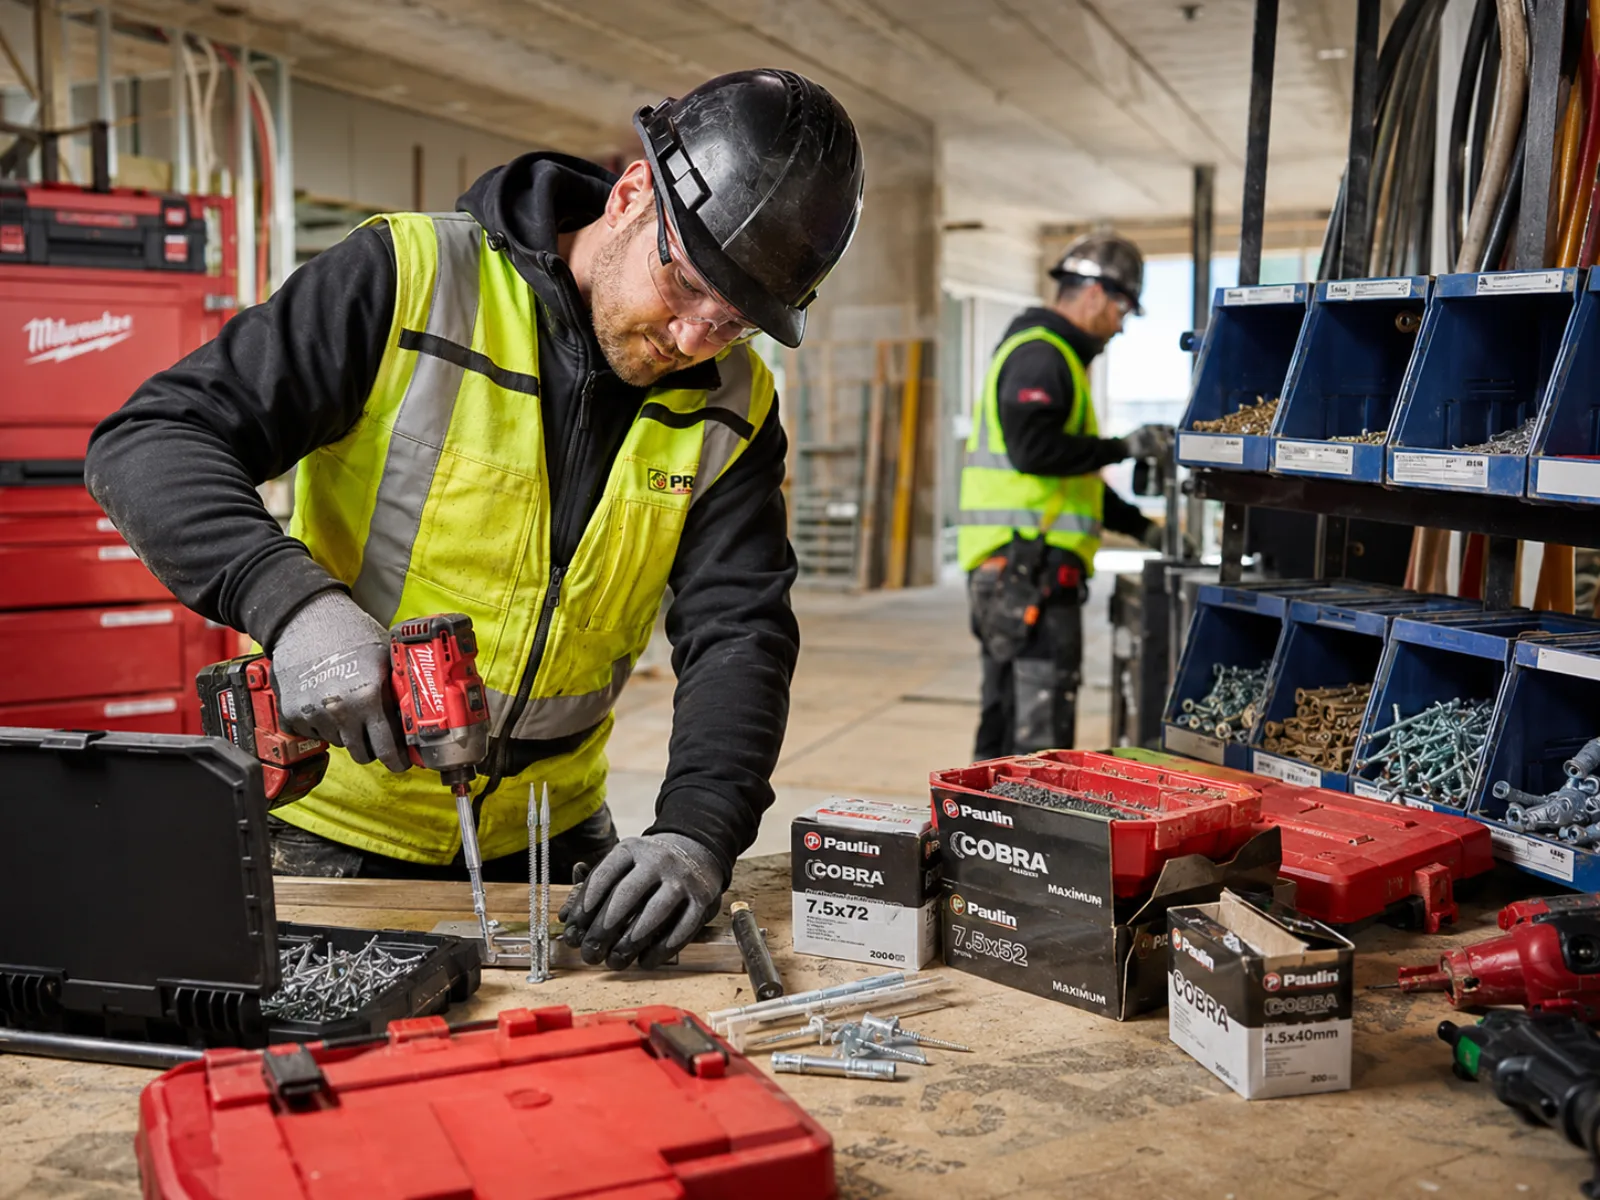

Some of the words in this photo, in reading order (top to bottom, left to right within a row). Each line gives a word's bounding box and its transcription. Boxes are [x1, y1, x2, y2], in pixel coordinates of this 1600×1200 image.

[960, 804, 1014, 826] Paulin
[823, 836, 880, 855] Paulin
[955, 834, 1049, 875] COBRA
[809, 861, 885, 885] COBRA
[806, 899, 869, 921] 7.5x72
[967, 901, 1017, 927] Paulin
[952, 924, 1028, 967] 7.5x52
[1283, 969, 1339, 987] Paulin
[1173, 969, 1230, 1033] COBRA
[1266, 993, 1339, 1016] COBRA
[1265, 1028, 1339, 1045] 4.5x40mm
